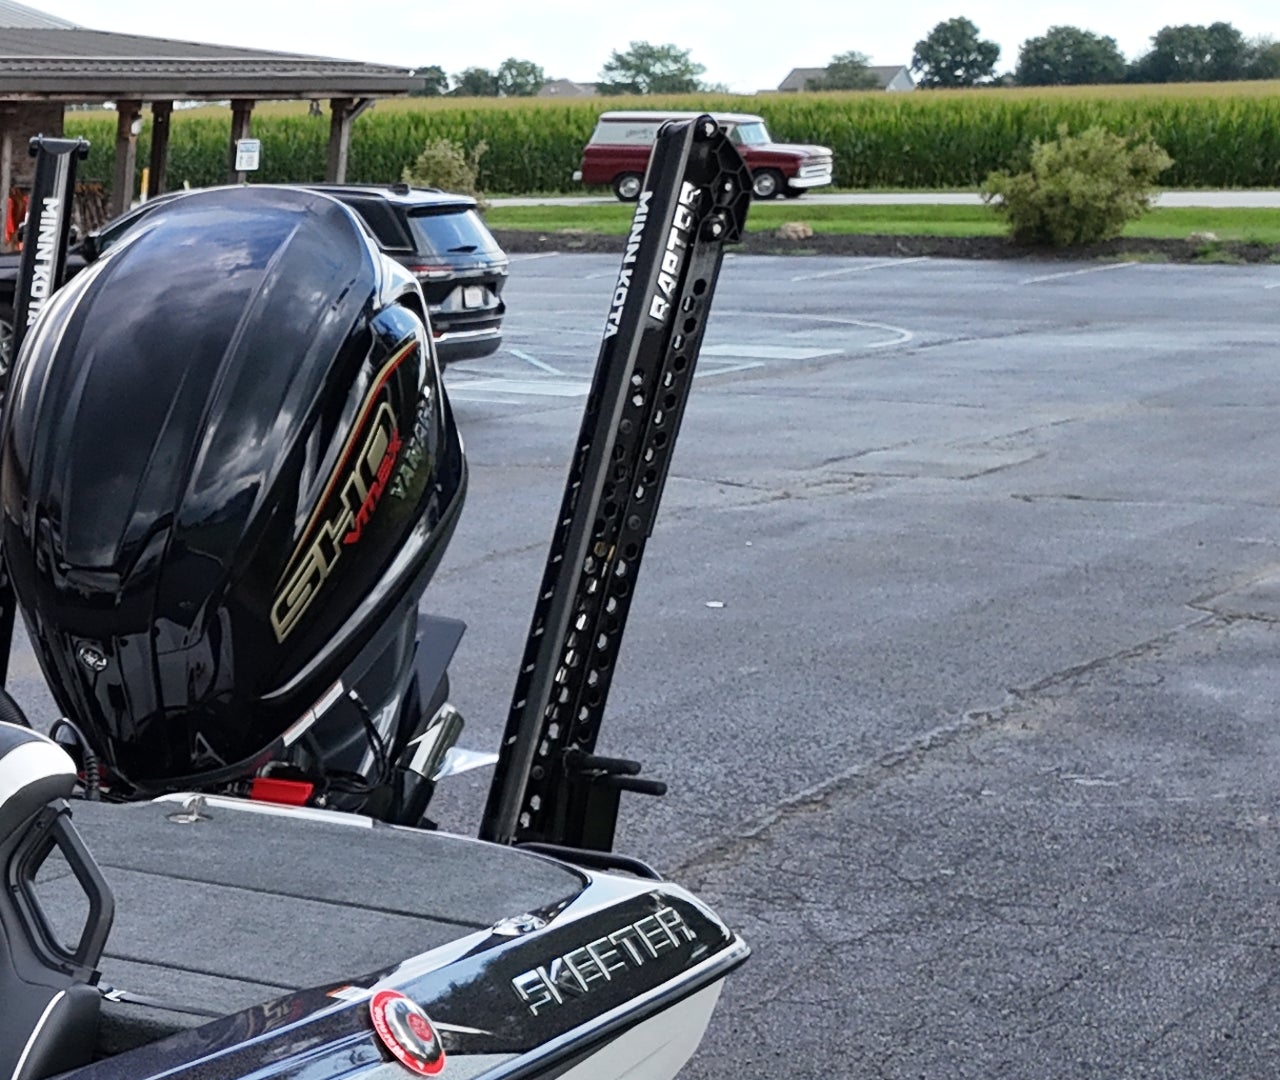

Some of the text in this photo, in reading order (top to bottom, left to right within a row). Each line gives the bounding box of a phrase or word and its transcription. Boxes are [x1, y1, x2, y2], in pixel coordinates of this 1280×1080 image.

[35, 198, 59, 260] MINN
[604, 191, 653, 340] MINN KOTA
[649, 181, 701, 322] RAPTOR
[270, 401, 398, 644] SHO
[511, 907, 697, 1016] SKEETER
